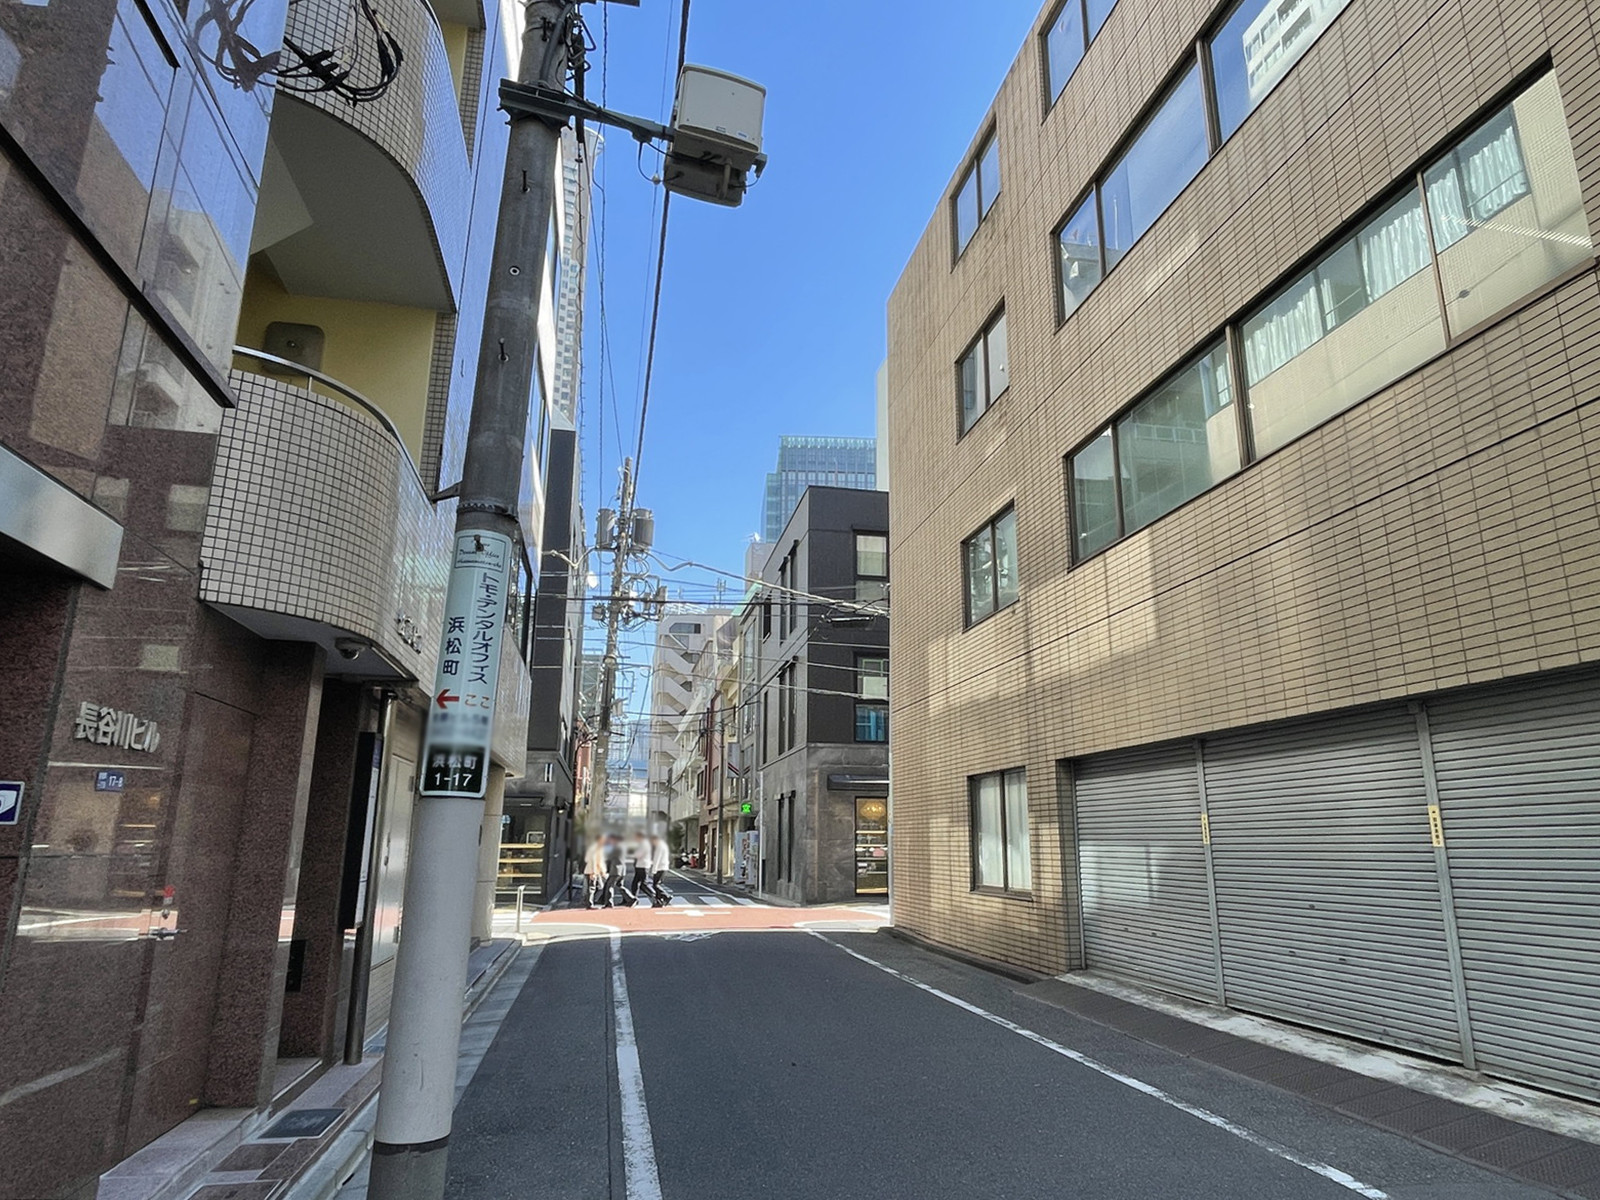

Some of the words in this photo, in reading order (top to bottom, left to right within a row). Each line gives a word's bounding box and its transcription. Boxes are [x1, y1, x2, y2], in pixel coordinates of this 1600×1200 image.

[443, 616, 465, 675] 浜松町
[468, 572, 499, 684] トモ・デンタルオフィス
[75, 701, 160, 753] 長谷川ビル
[465, 693, 491, 709] ここ
[434, 772, 473, 787] 1-17
